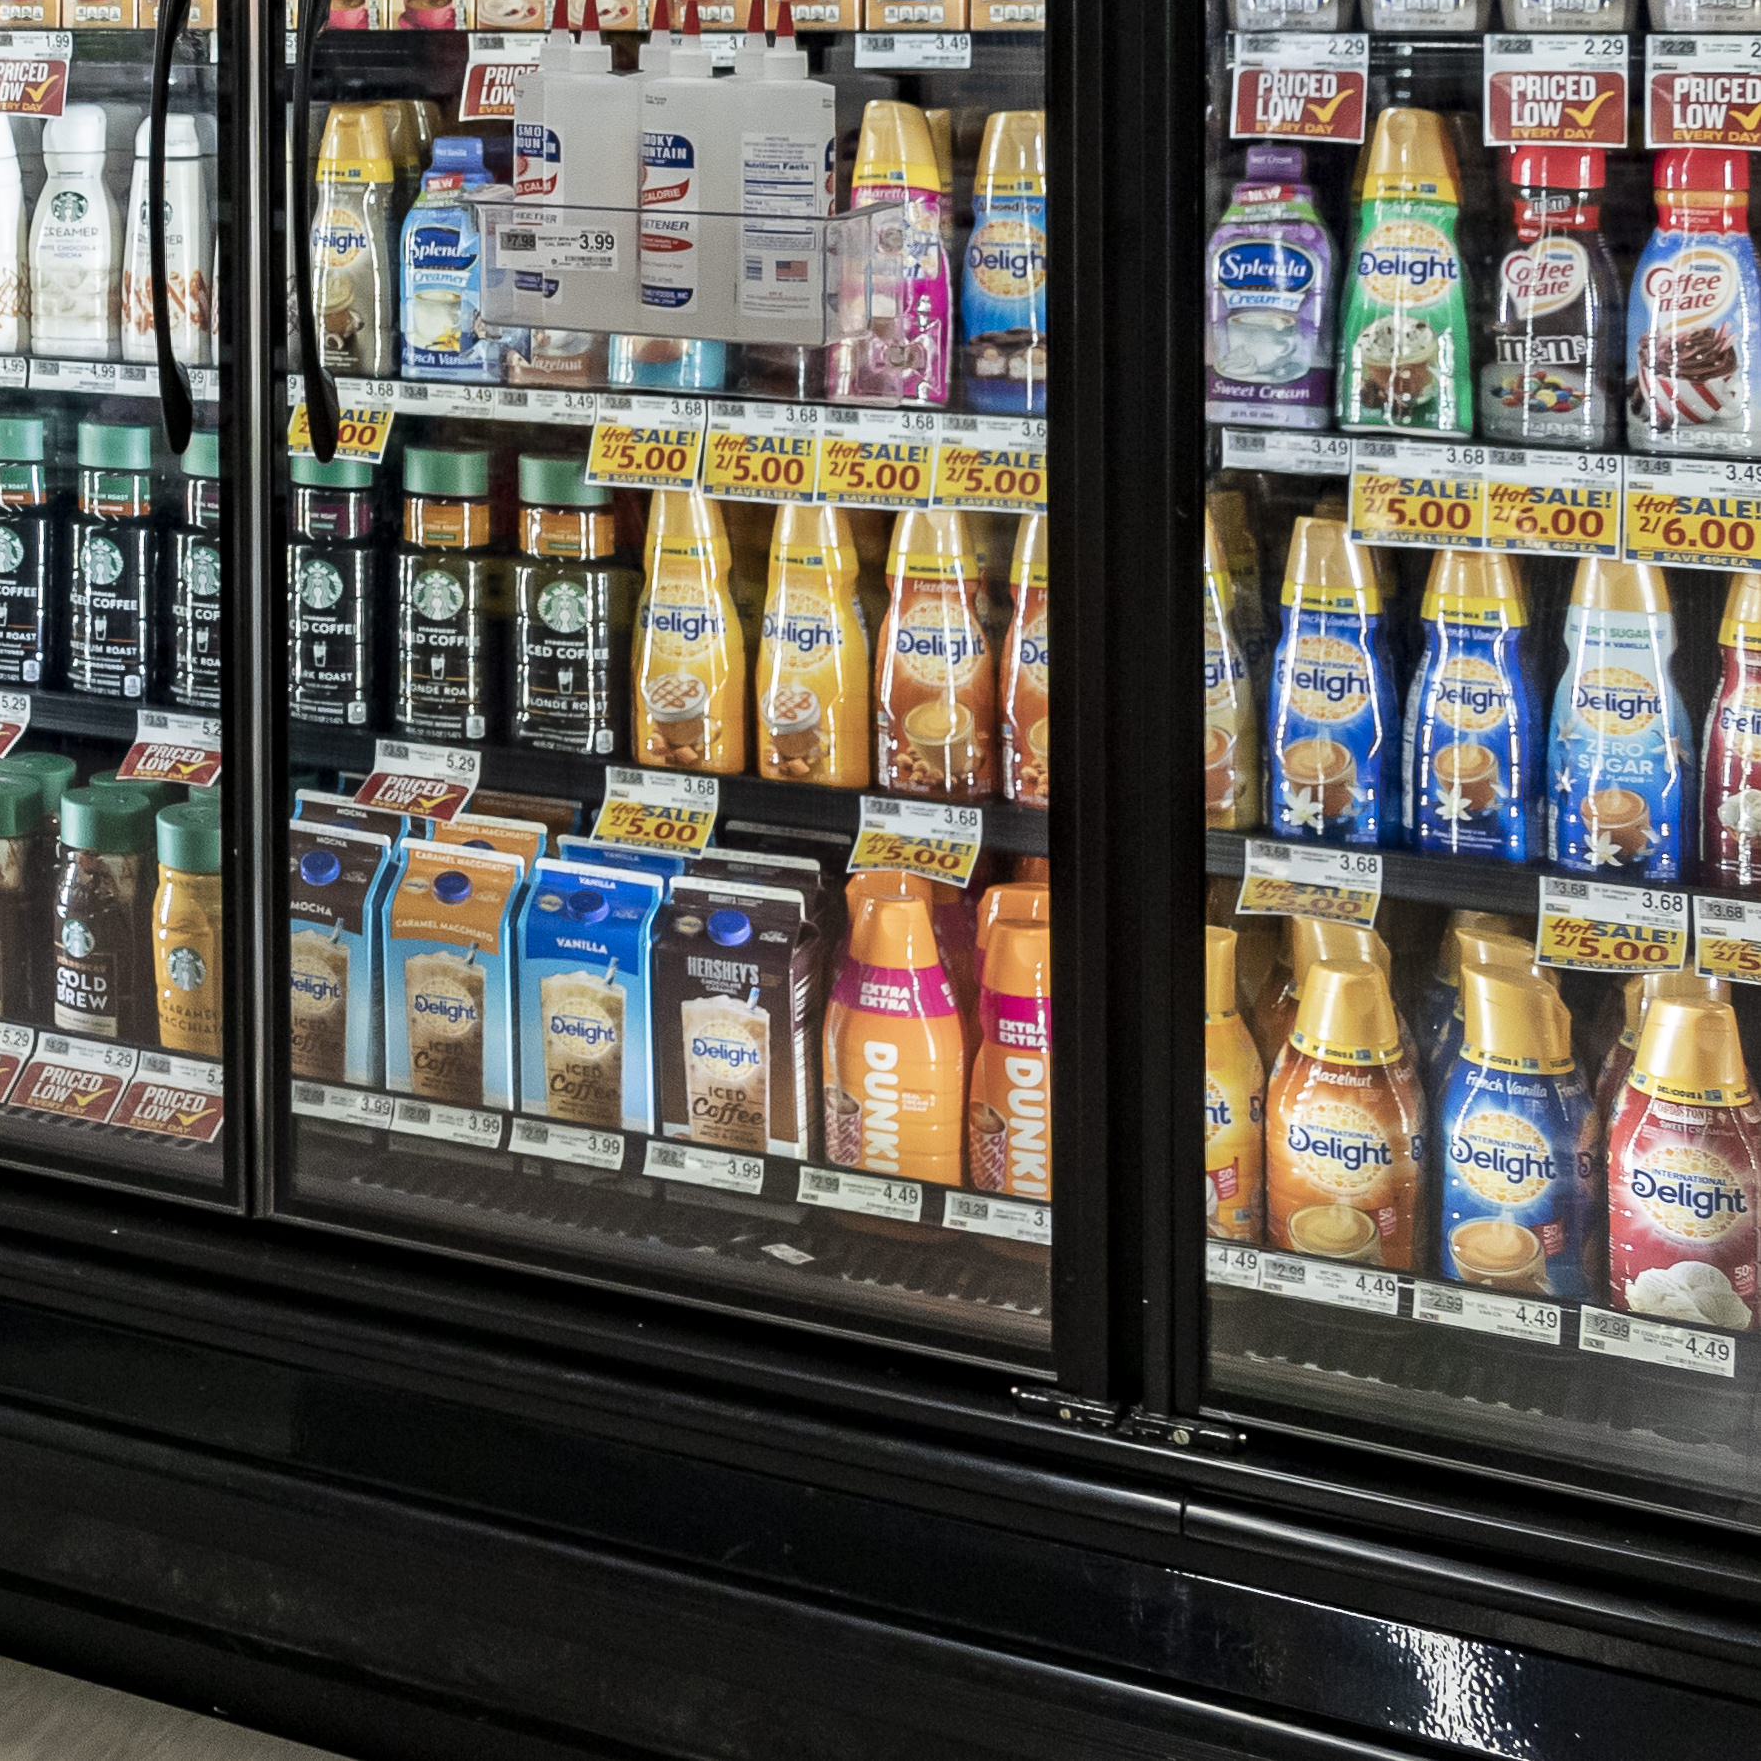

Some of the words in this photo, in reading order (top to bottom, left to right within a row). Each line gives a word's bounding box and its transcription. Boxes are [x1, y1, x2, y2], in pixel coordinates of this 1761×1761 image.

[935, 36, 969, 53] 3.49
[1584, 38, 1624, 56] 2.29
[1510, 74, 1597, 102] PRICED
[19, 102, 44, 113] DAY
[1510, 100, 1562, 127] LOW
[1511, 127, 1561, 140] EVERY
[1563, 128, 1596, 140] DAY
[744, 162, 780, 171] Nutrition
[782, 162, 809, 172] Facts
[579, 233, 614, 251] 3.99
[1219, 253, 1308, 282] Splenda
[1358, 250, 1458, 286] Delight
[1645, 267, 1721, 303] Coffee
[1659, 289, 1716, 312] mate
[1212, 380, 1256, 398] Sweet
[1258, 384, 1310, 400] Cream
[901, 413, 935, 431] 3.68
[1446, 447, 1485, 465] 3.68
[1577, 456, 1618, 474] 3.49
[828, 459, 920, 492] 2/5.00
[1492, 505, 1605, 539] 2/6.00
[1638, 516, 1756, 551] 2/6.00
[1662, 552, 1700, 563] SAVE
[93, 598, 138, 611] COFFEE
[1585, 740, 1644, 757] ZERO
[446, 755, 476, 773] 5.29
[1578, 757, 1654, 775] SUGAR
[1641, 892, 1684, 912] 3.68
[556, 937, 609, 956] VANILLA
[687, 955, 760, 987] HERSHEY'S
[859, 981, 911, 998] EXTRA
[859, 995, 910, 1013] EXTRA
[104, 1051, 132, 1067] 5.29
[691, 1038, 760, 1068] Delight
[1309, 1065, 1373, 1089] Hazelnut
[1465, 1069, 1505, 1096] French
[1506, 1078, 1548, 1099] Vanilla
[144, 1085, 207, 1114] PRICED
[708, 1087, 747, 1103] ICED
[133, 1101, 174, 1124] LOW
[691, 1096, 765, 1125] Coffee
[1004, 1055, 1048, 1201] DUNKI
[1305, 1123, 1374, 1140] INTERNATIONAL
[1288, 1125, 1392, 1171] Delight
[1651, 1168, 1727, 1187] INTERNATIONAL
[883, 1184, 919, 1204] 4.49
[1632, 1170, 1748, 1219] Delight
[1685, 1336, 1730, 1361] 4.49
